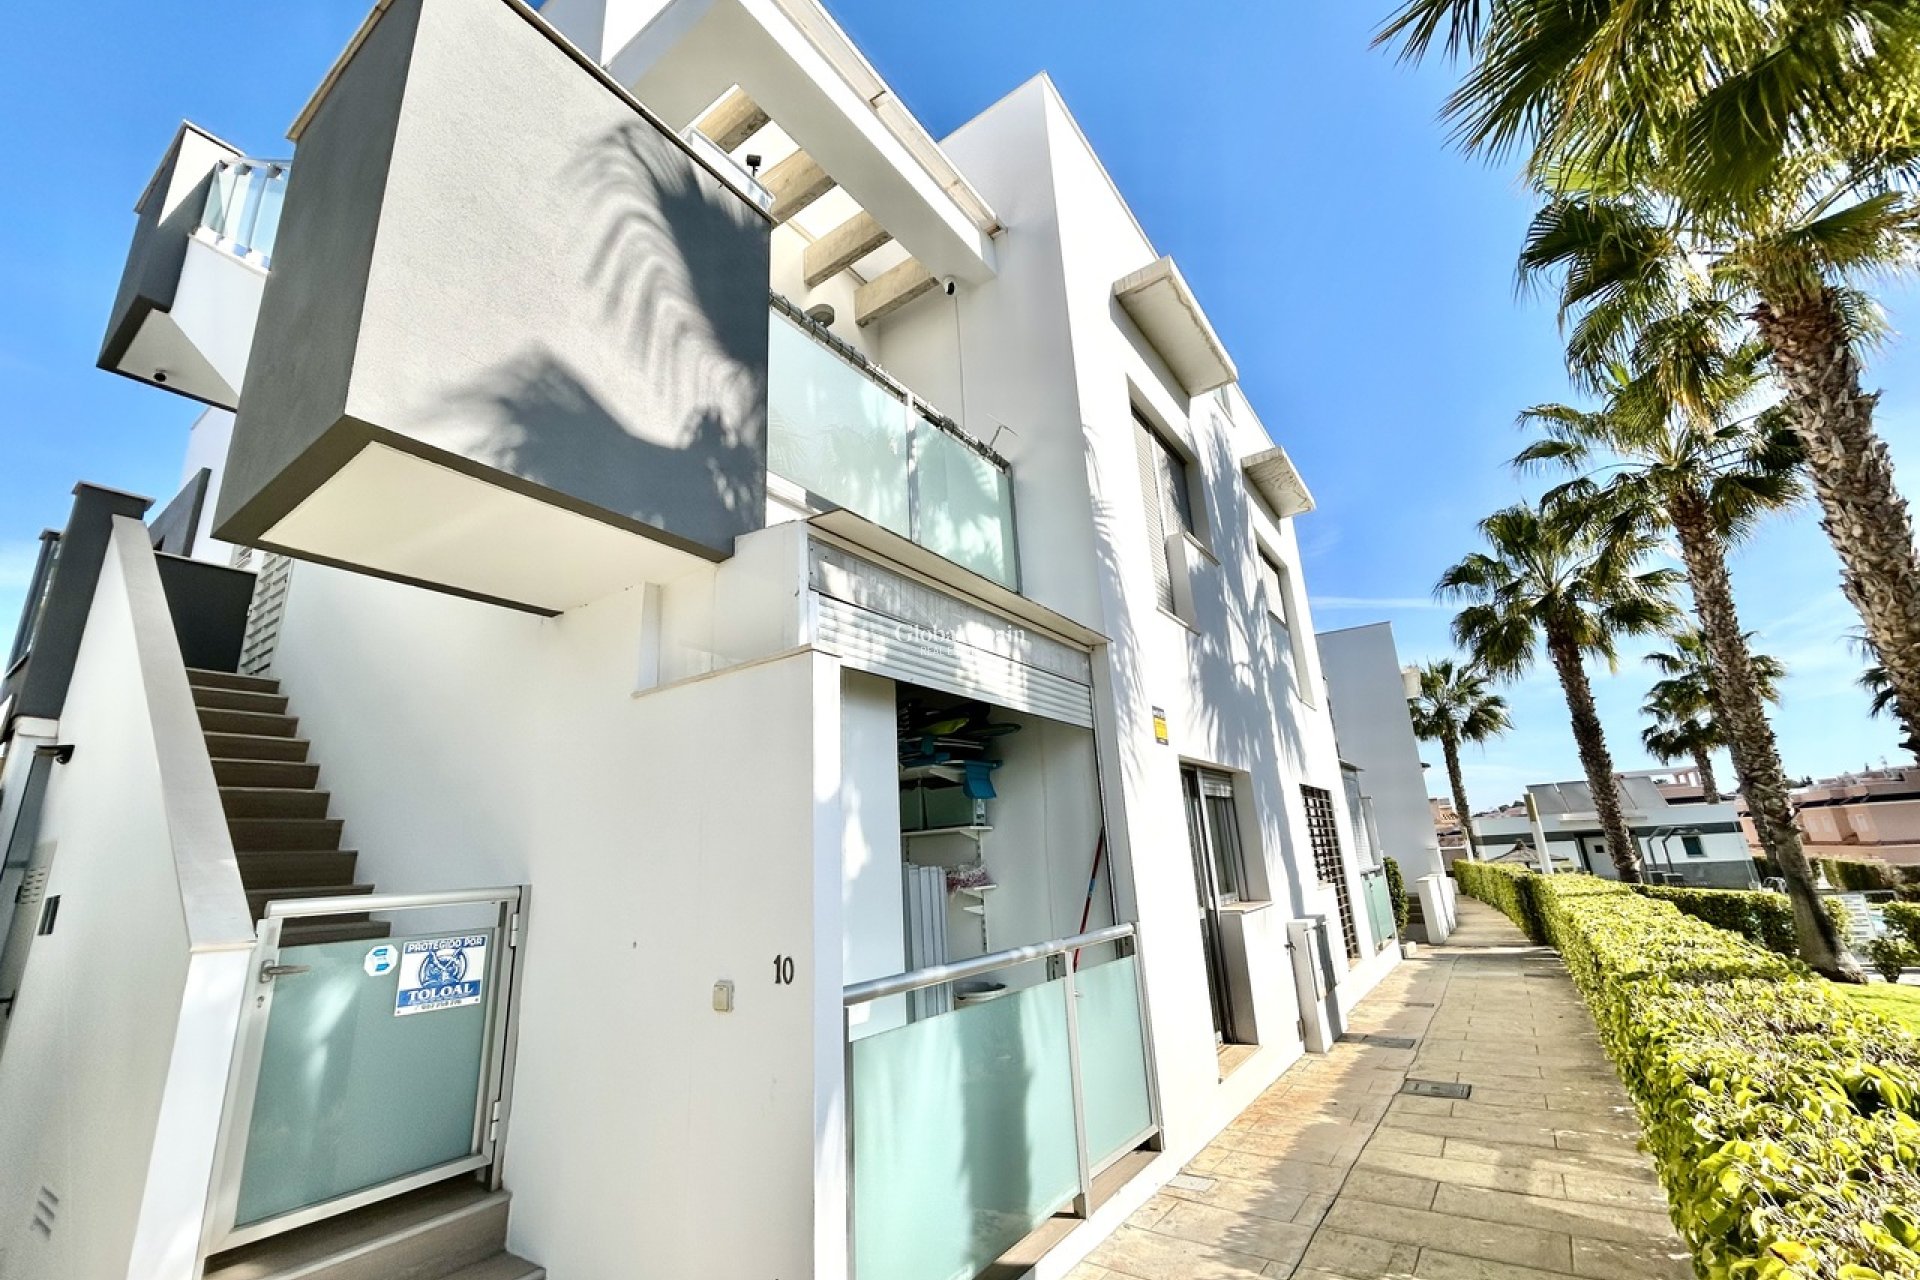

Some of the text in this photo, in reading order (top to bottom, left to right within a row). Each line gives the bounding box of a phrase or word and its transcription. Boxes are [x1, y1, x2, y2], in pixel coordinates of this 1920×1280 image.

[407, 936, 483, 953] PROTEGIDO POR
[773, 954, 795, 985] 10
[408, 983, 474, 1001] TOLOAL
